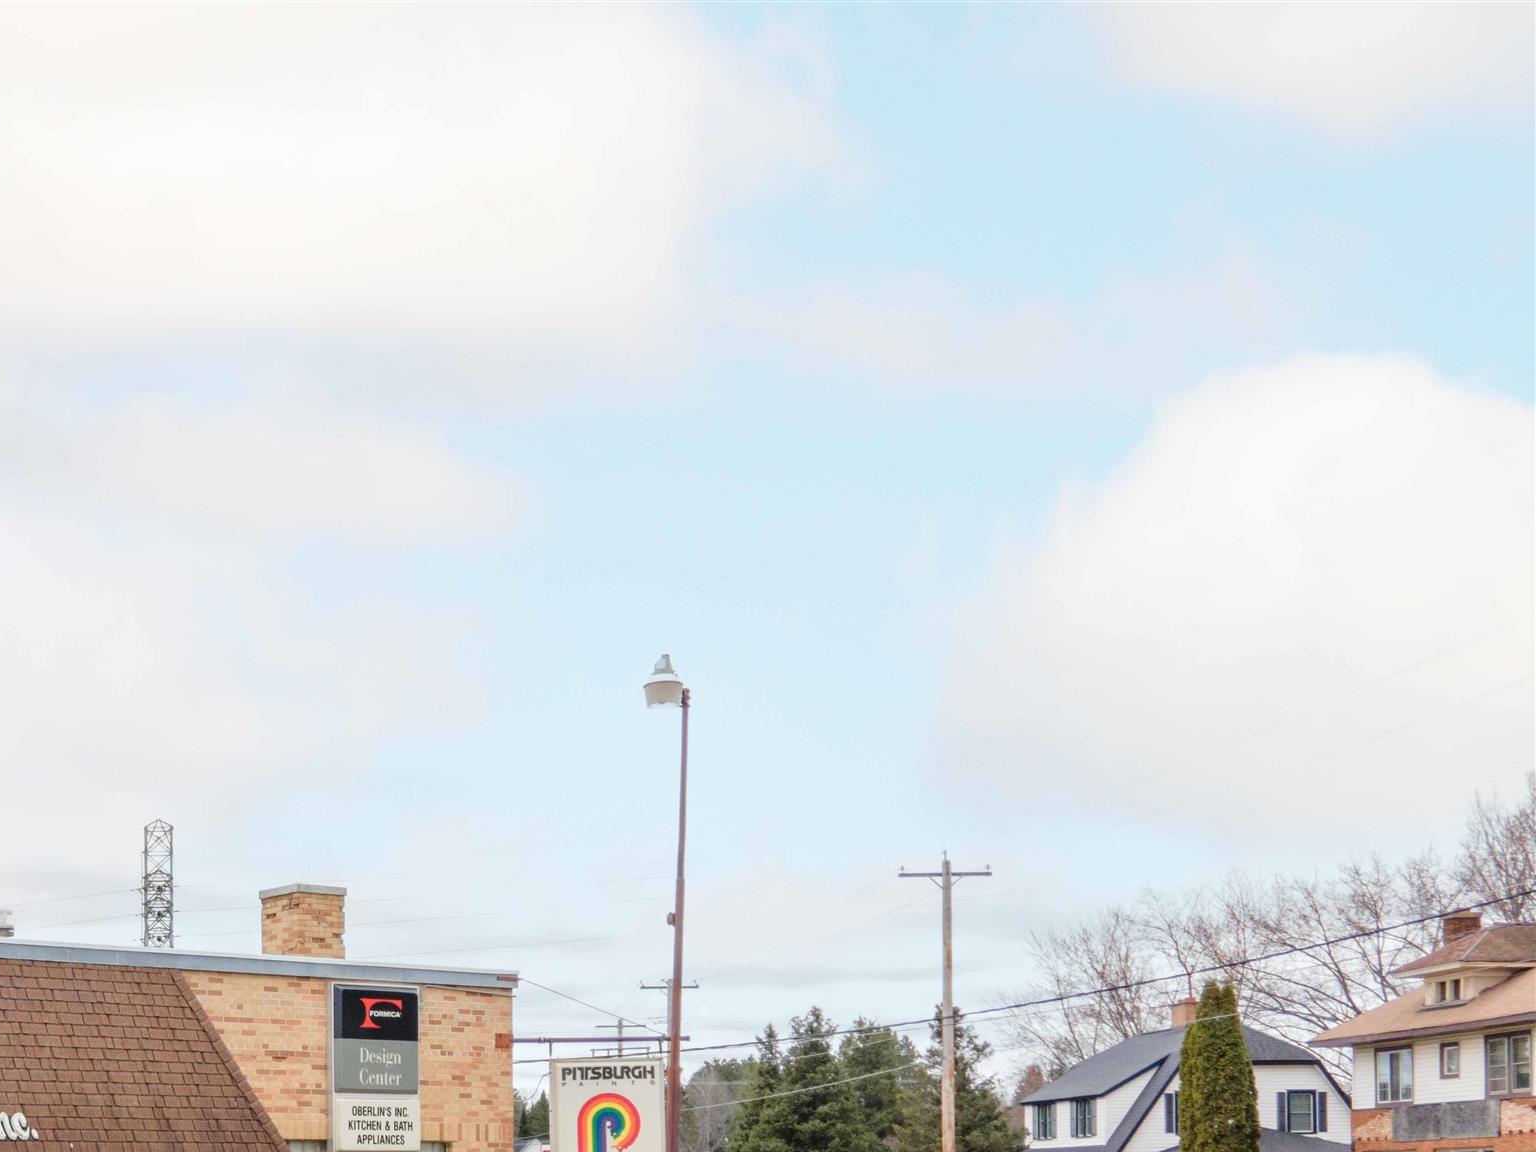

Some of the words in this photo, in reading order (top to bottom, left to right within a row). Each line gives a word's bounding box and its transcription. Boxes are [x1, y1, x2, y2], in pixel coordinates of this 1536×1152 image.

[369, 1010, 401, 1018] FORMICA
[359, 1047, 402, 1067] Design
[359, 1068, 402, 1086] Center
[561, 1065, 655, 1081] PITTSBURGH
[351, 1105, 392, 1117] OBERLIN'S
[394, 1107, 410, 1118] INC.
[348, 1120, 382, 1131] KITCHEN
[384, 1121, 391, 1131] &
[393, 1121, 413, 1131] BATH
[356, 1134, 406, 1145] APPLIANCES
